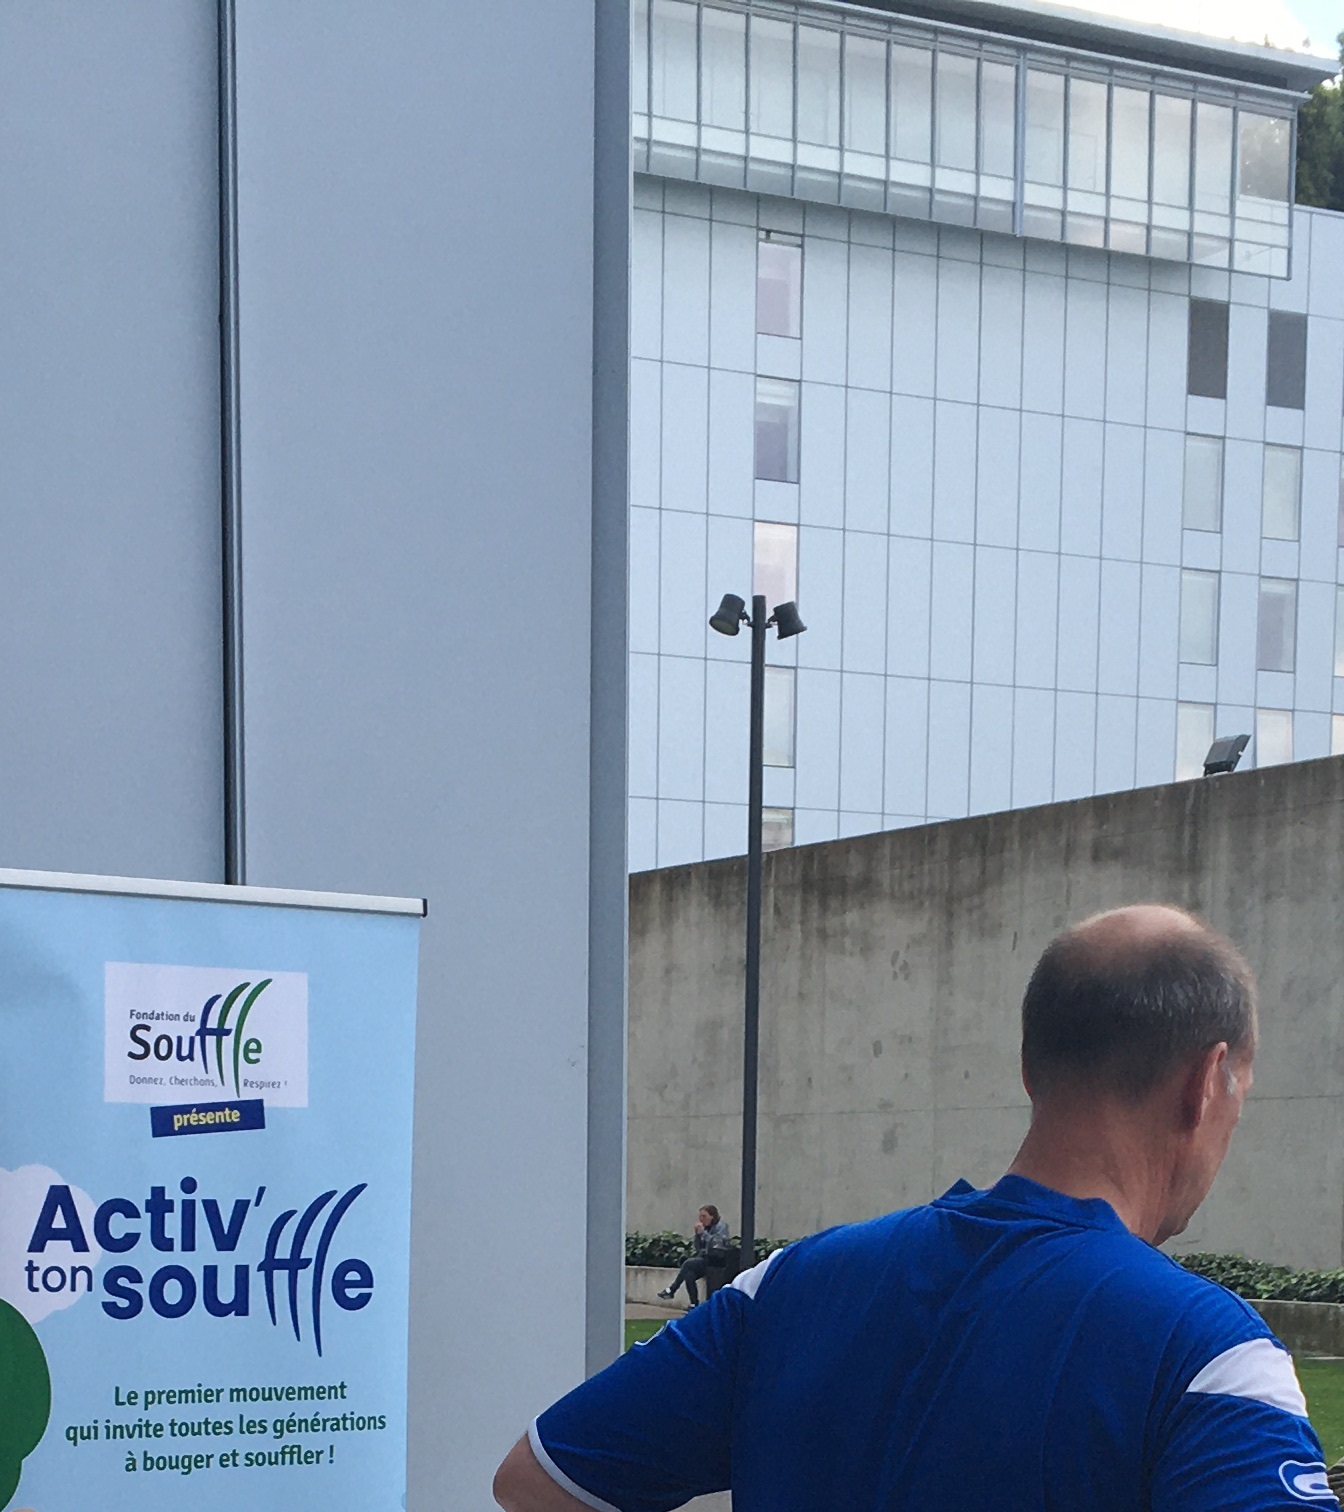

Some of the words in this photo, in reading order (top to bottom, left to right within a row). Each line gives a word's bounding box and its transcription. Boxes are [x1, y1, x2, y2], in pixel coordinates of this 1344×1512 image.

[129, 1009, 181, 1022] Fondation
[183, 1011, 196, 1022] du
[127, 978, 273, 1098] Souffle
[243, 1079, 281, 1091] Respirez
[173, 1108, 241, 1131] présente
[26, 1176, 267, 1253] Activ'
[24, 1259, 94, 1293] ton
[101, 1183, 374, 1357] souffle
[114, 1386, 138, 1406] Le
[144, 1383, 224, 1410] premier
[229, 1381, 348, 1404] mouvement
[65, 1420, 99, 1446] qui
[104, 1417, 164, 1441] invite
[169, 1416, 233, 1438] toutes
[239, 1414, 268, 1436] les
[273, 1411, 387, 1445] générations
[125, 1450, 138, 1472] à
[143, 1449, 214, 1475] bouger
[219, 1449, 239, 1469] et
[244, 1445, 323, 1468] souffler
[329, 1445, 335, 1464] !
